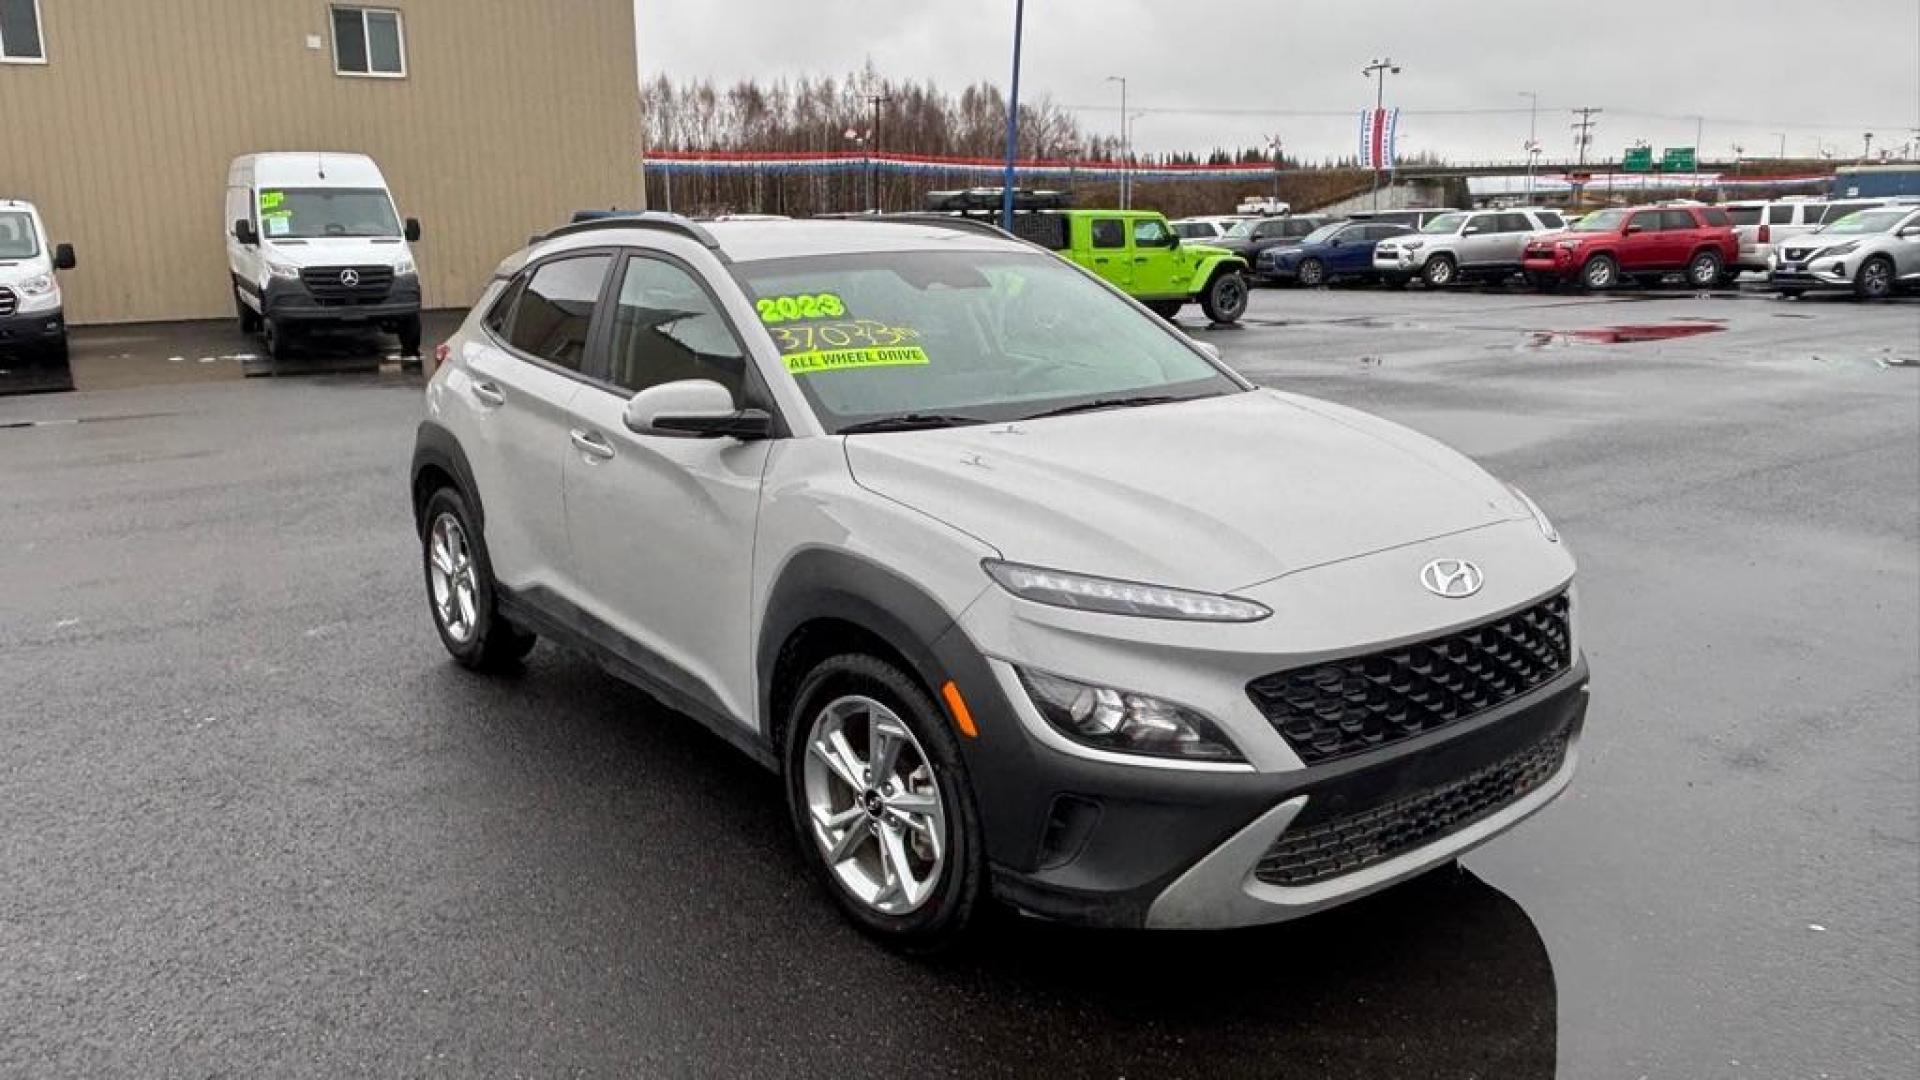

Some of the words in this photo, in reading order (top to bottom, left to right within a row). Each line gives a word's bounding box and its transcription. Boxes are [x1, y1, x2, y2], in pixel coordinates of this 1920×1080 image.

[757, 294, 845, 321] 2023
[790, 356, 817, 369] ALL
[822, 351, 873, 365] WHEEL
[878, 348, 921, 361] DRIVE
